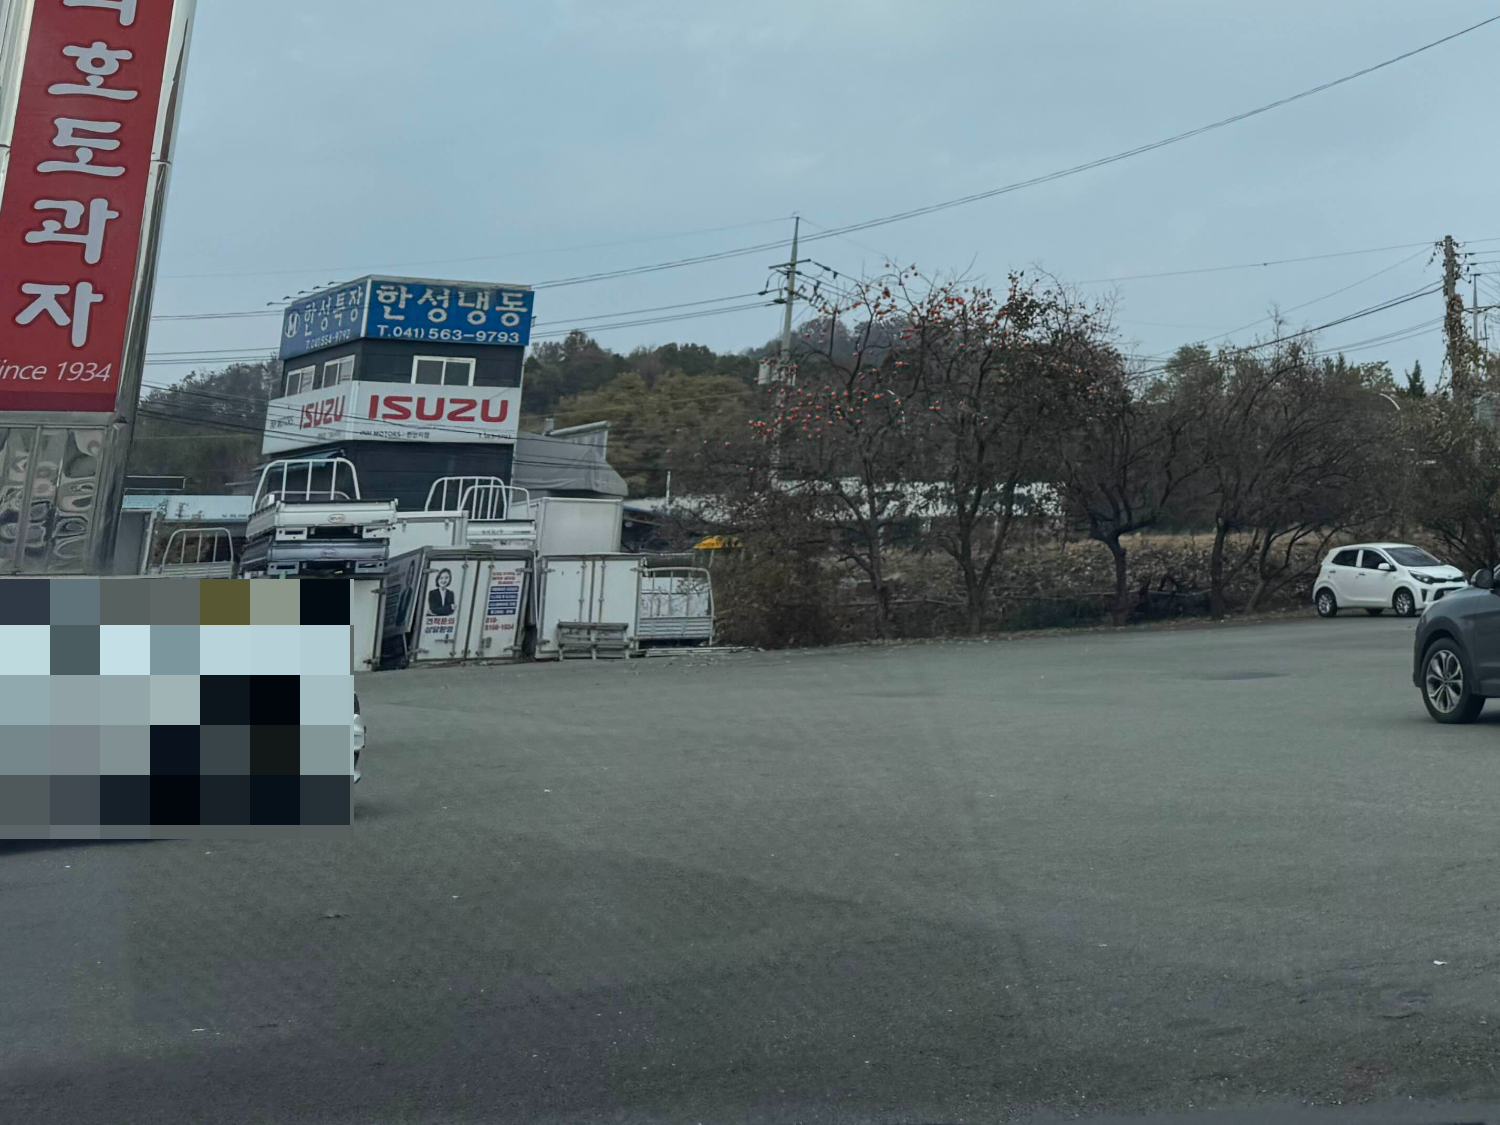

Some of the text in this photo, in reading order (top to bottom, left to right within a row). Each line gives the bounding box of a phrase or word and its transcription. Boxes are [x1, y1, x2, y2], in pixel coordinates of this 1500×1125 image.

[303, 286, 364, 337] 한성특장
[376, 284, 529, 327] 한성냉동
[428, 328, 520, 343] 563-9793
[0, 358, 113, 382] ince 1934
[299, 395, 346, 430] ISUZU
[368, 394, 509, 423] ISUZU
